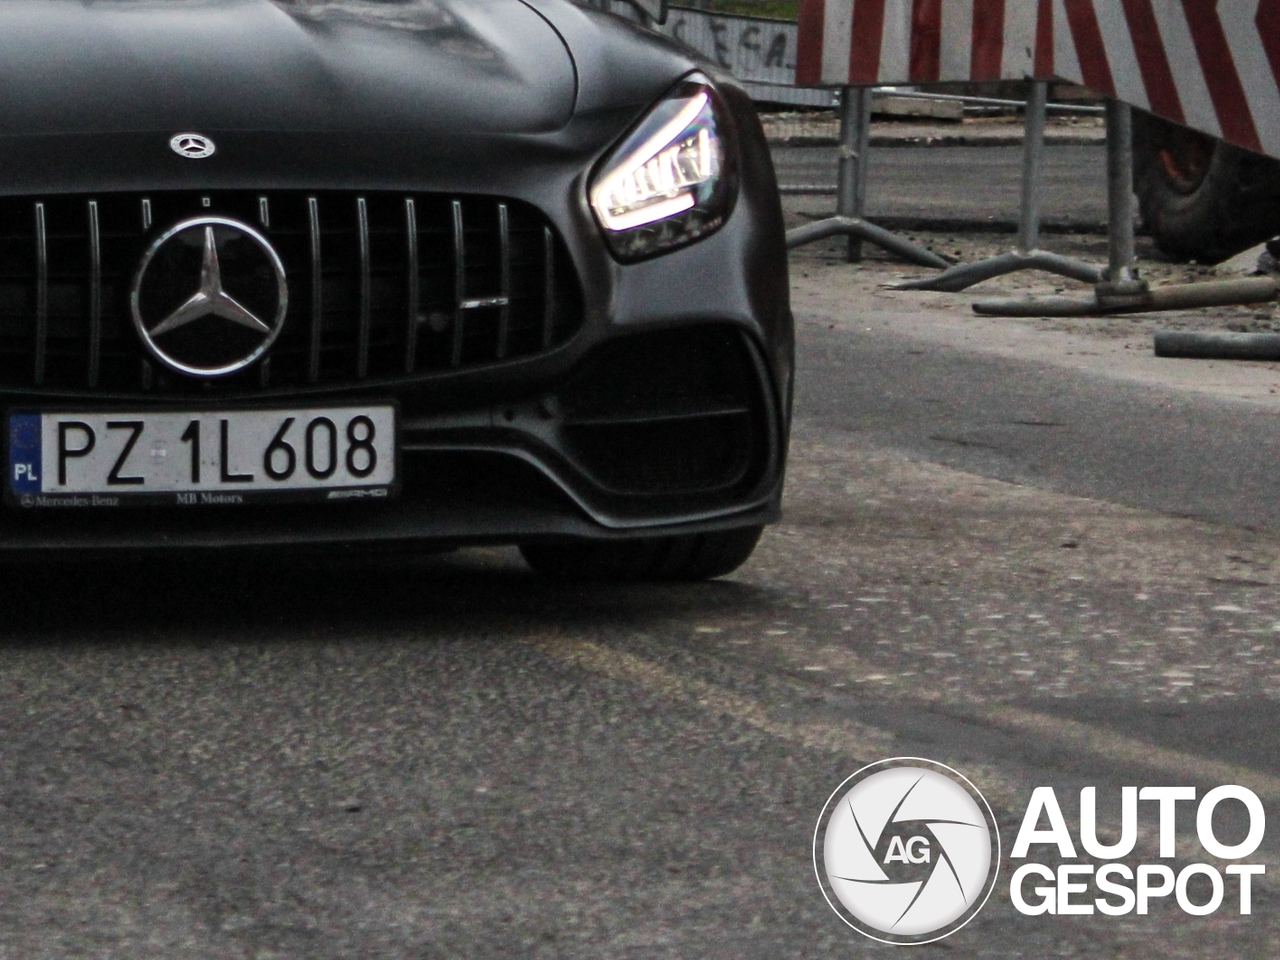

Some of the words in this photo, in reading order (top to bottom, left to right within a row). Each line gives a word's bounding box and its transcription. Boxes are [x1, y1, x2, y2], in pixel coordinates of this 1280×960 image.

[58, 420, 145, 486] PZ
[179, 414, 378, 484] 1L608
[14, 463, 38, 482] PL
[36, 495, 119, 507] Mercedes-Benz
[176, 493, 198, 505] MB
[201, 492, 243, 504] Motors
